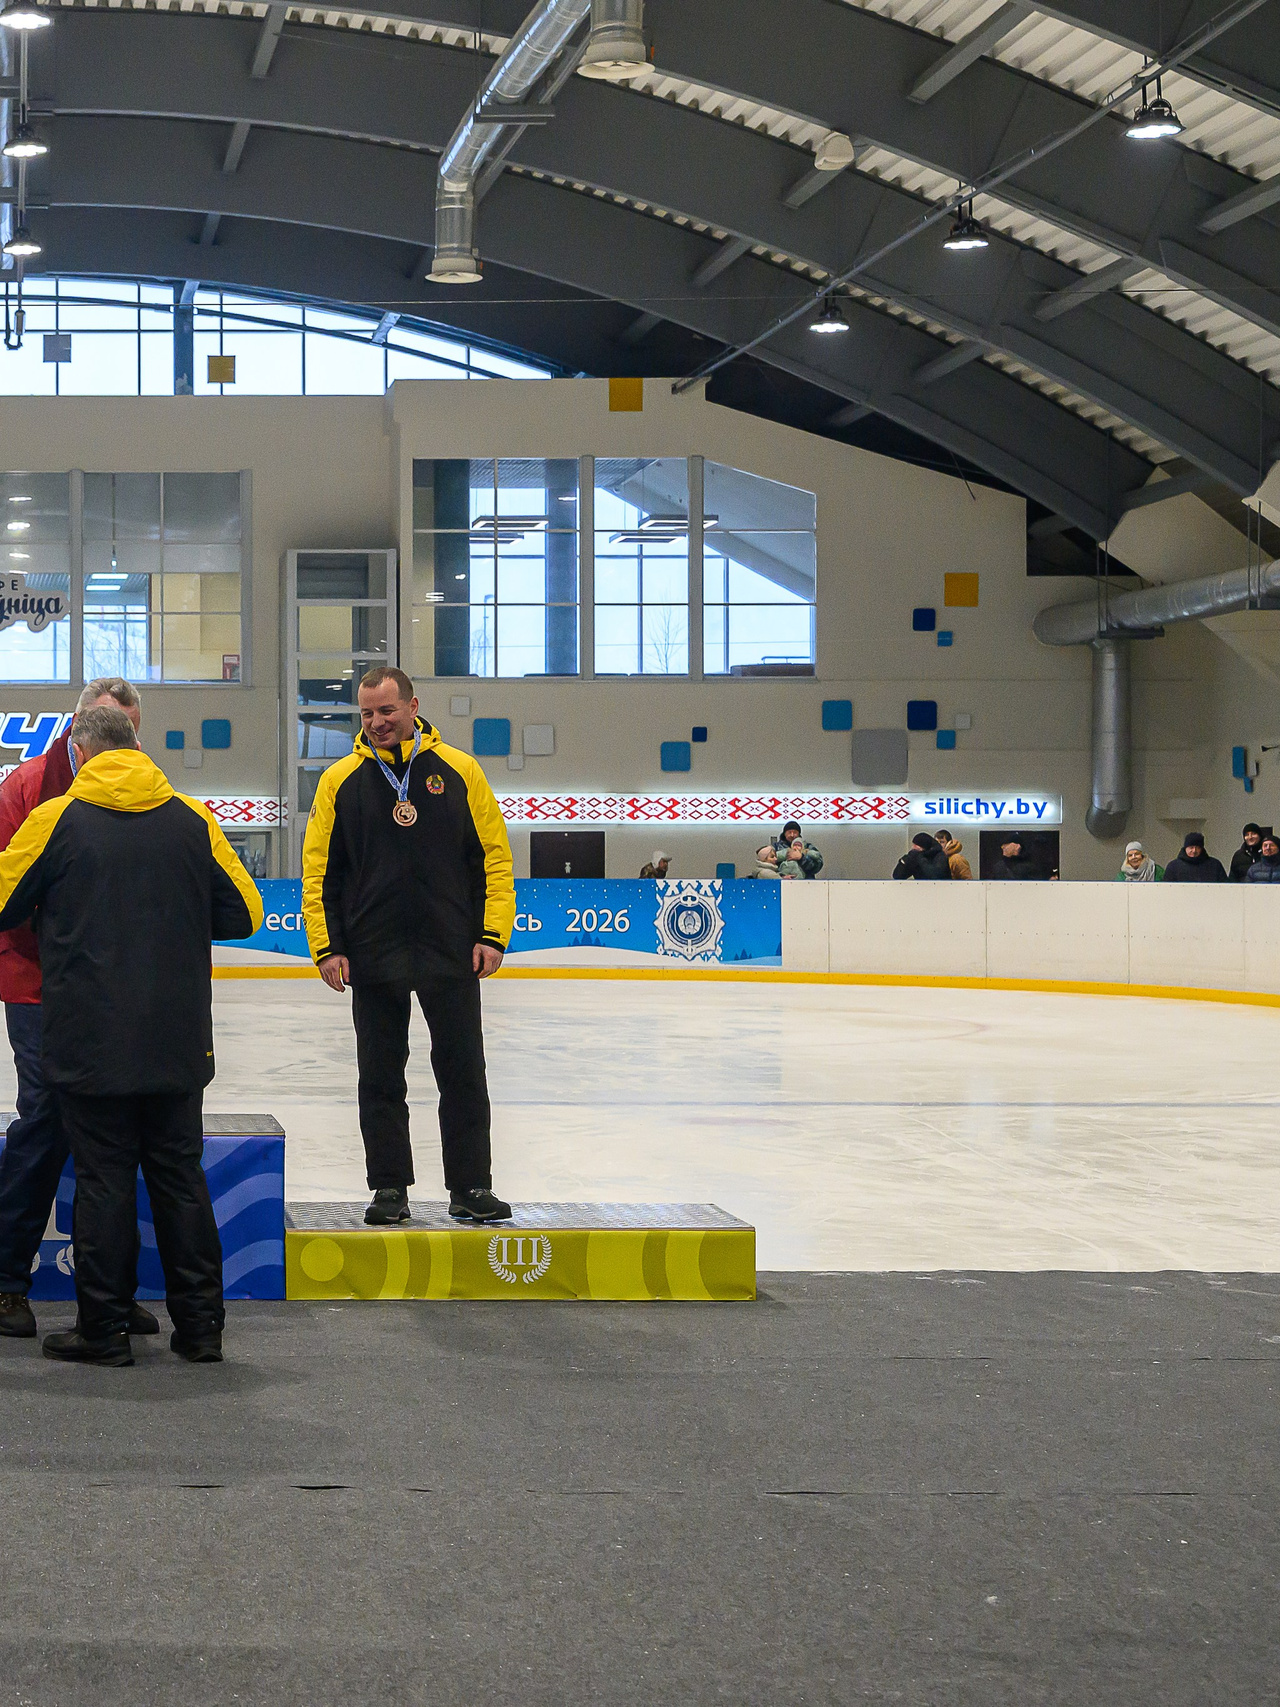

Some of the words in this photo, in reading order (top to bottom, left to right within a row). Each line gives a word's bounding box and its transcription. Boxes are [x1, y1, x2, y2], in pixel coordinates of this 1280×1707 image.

[924, 798, 1048, 819] silichy.by
[565, 908, 631, 933] 2026
[498, 1237, 541, 1266] III
